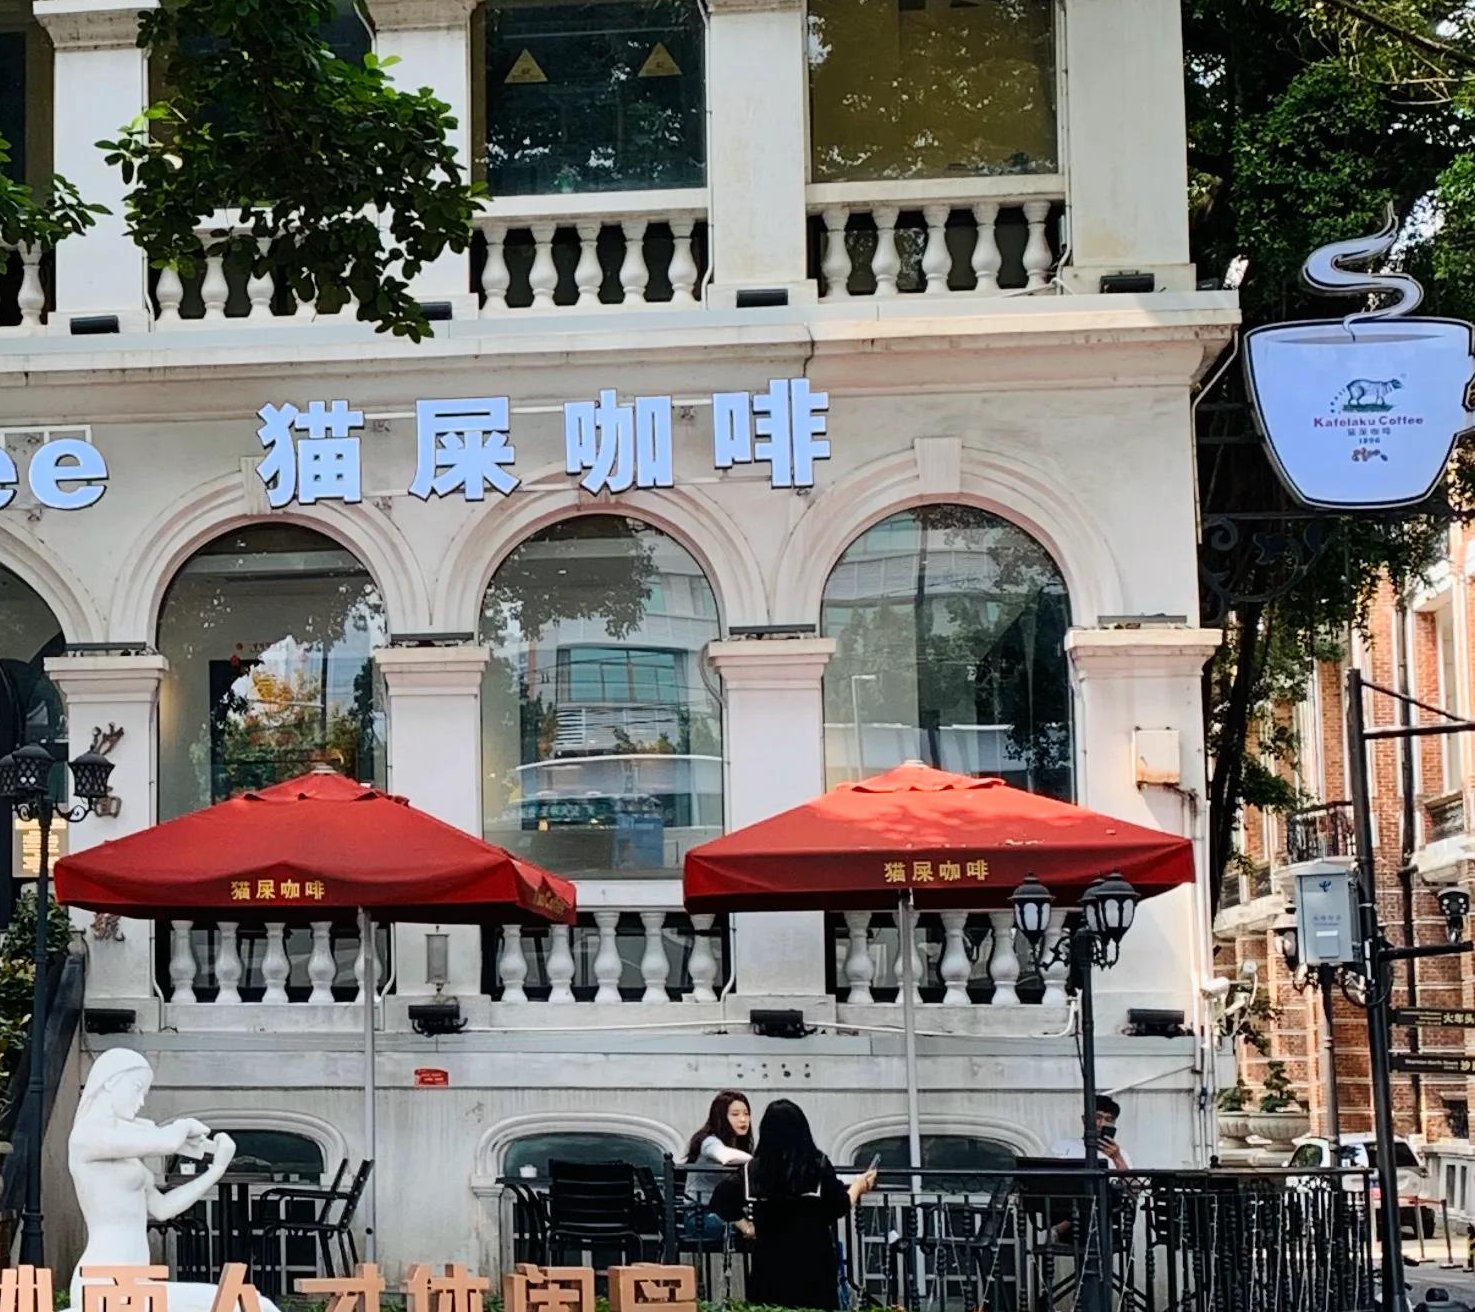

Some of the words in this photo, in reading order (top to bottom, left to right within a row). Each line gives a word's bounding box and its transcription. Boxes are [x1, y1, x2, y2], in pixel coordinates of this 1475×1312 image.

[1379, 415, 1424, 426] Coffee
[256, 378, 830, 508] 猫屎咖啡
[884, 859, 989, 883] 猫屎咖啡
[230, 878, 325, 900] 猫屎咖啡
